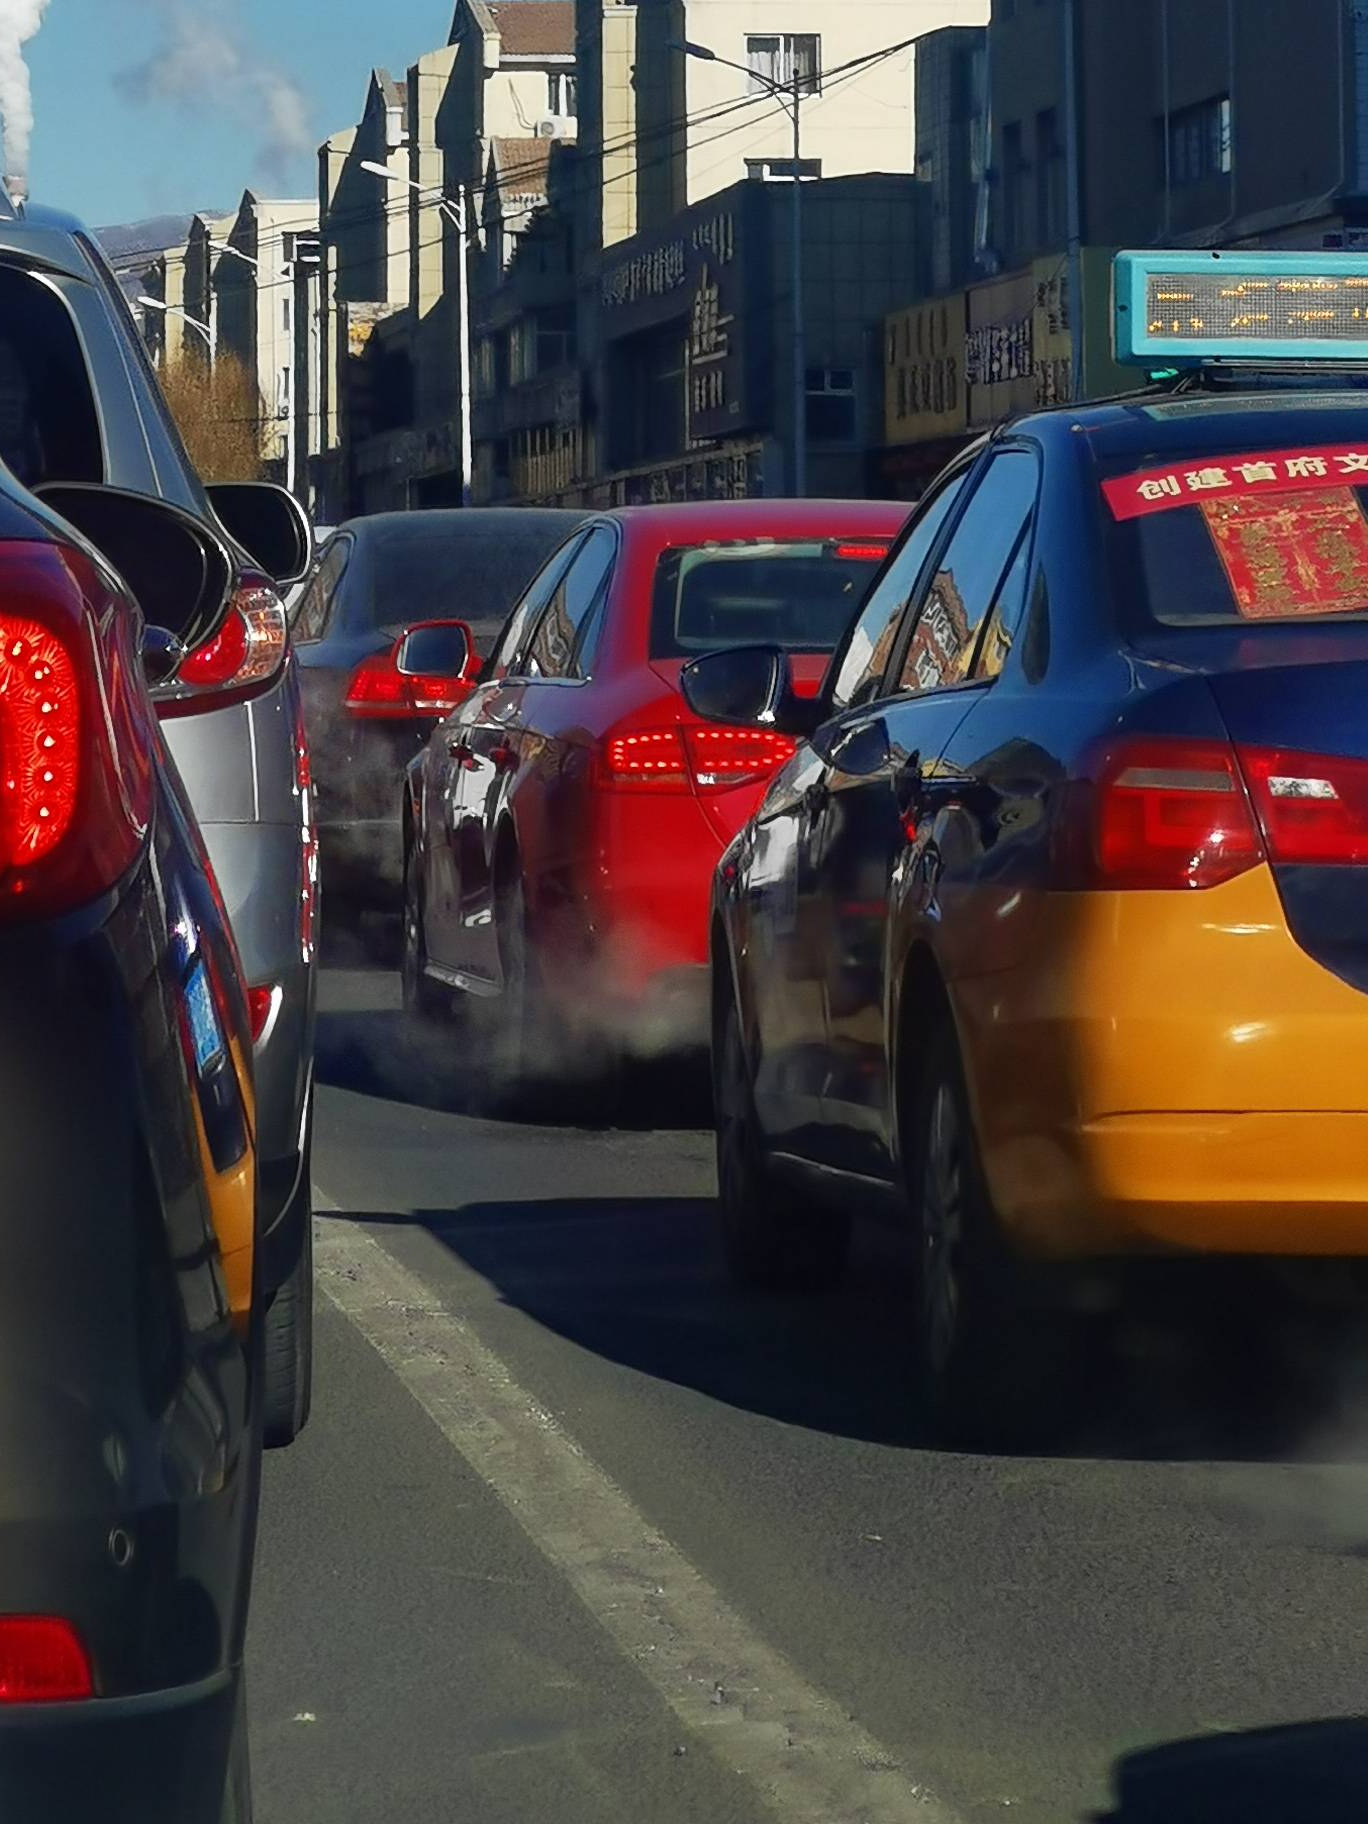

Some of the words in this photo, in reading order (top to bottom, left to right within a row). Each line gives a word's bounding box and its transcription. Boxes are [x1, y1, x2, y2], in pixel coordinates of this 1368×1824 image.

[1137, 453, 1368, 500] 创建首府文
